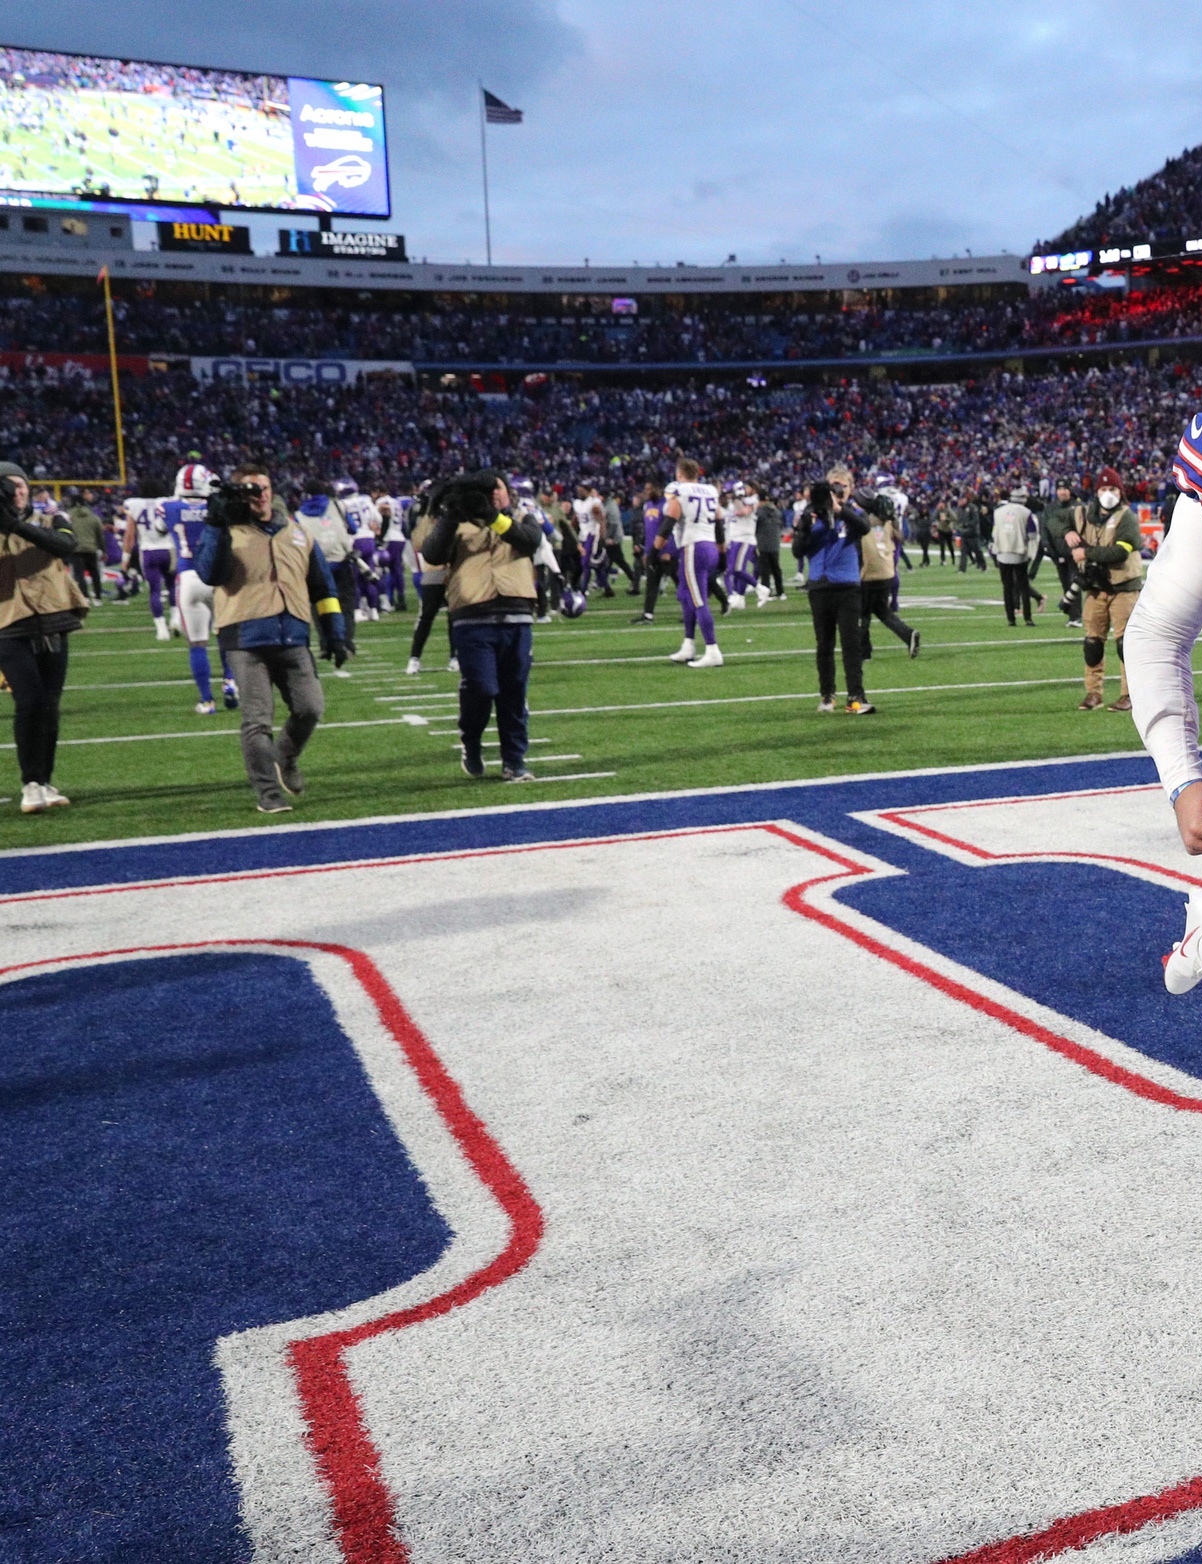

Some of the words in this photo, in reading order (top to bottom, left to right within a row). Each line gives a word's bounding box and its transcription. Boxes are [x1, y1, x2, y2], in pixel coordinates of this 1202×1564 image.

[173, 222, 234, 242] HUNT
[321, 231, 398, 248] IMAGINE
[689, 496, 716, 523] 75
